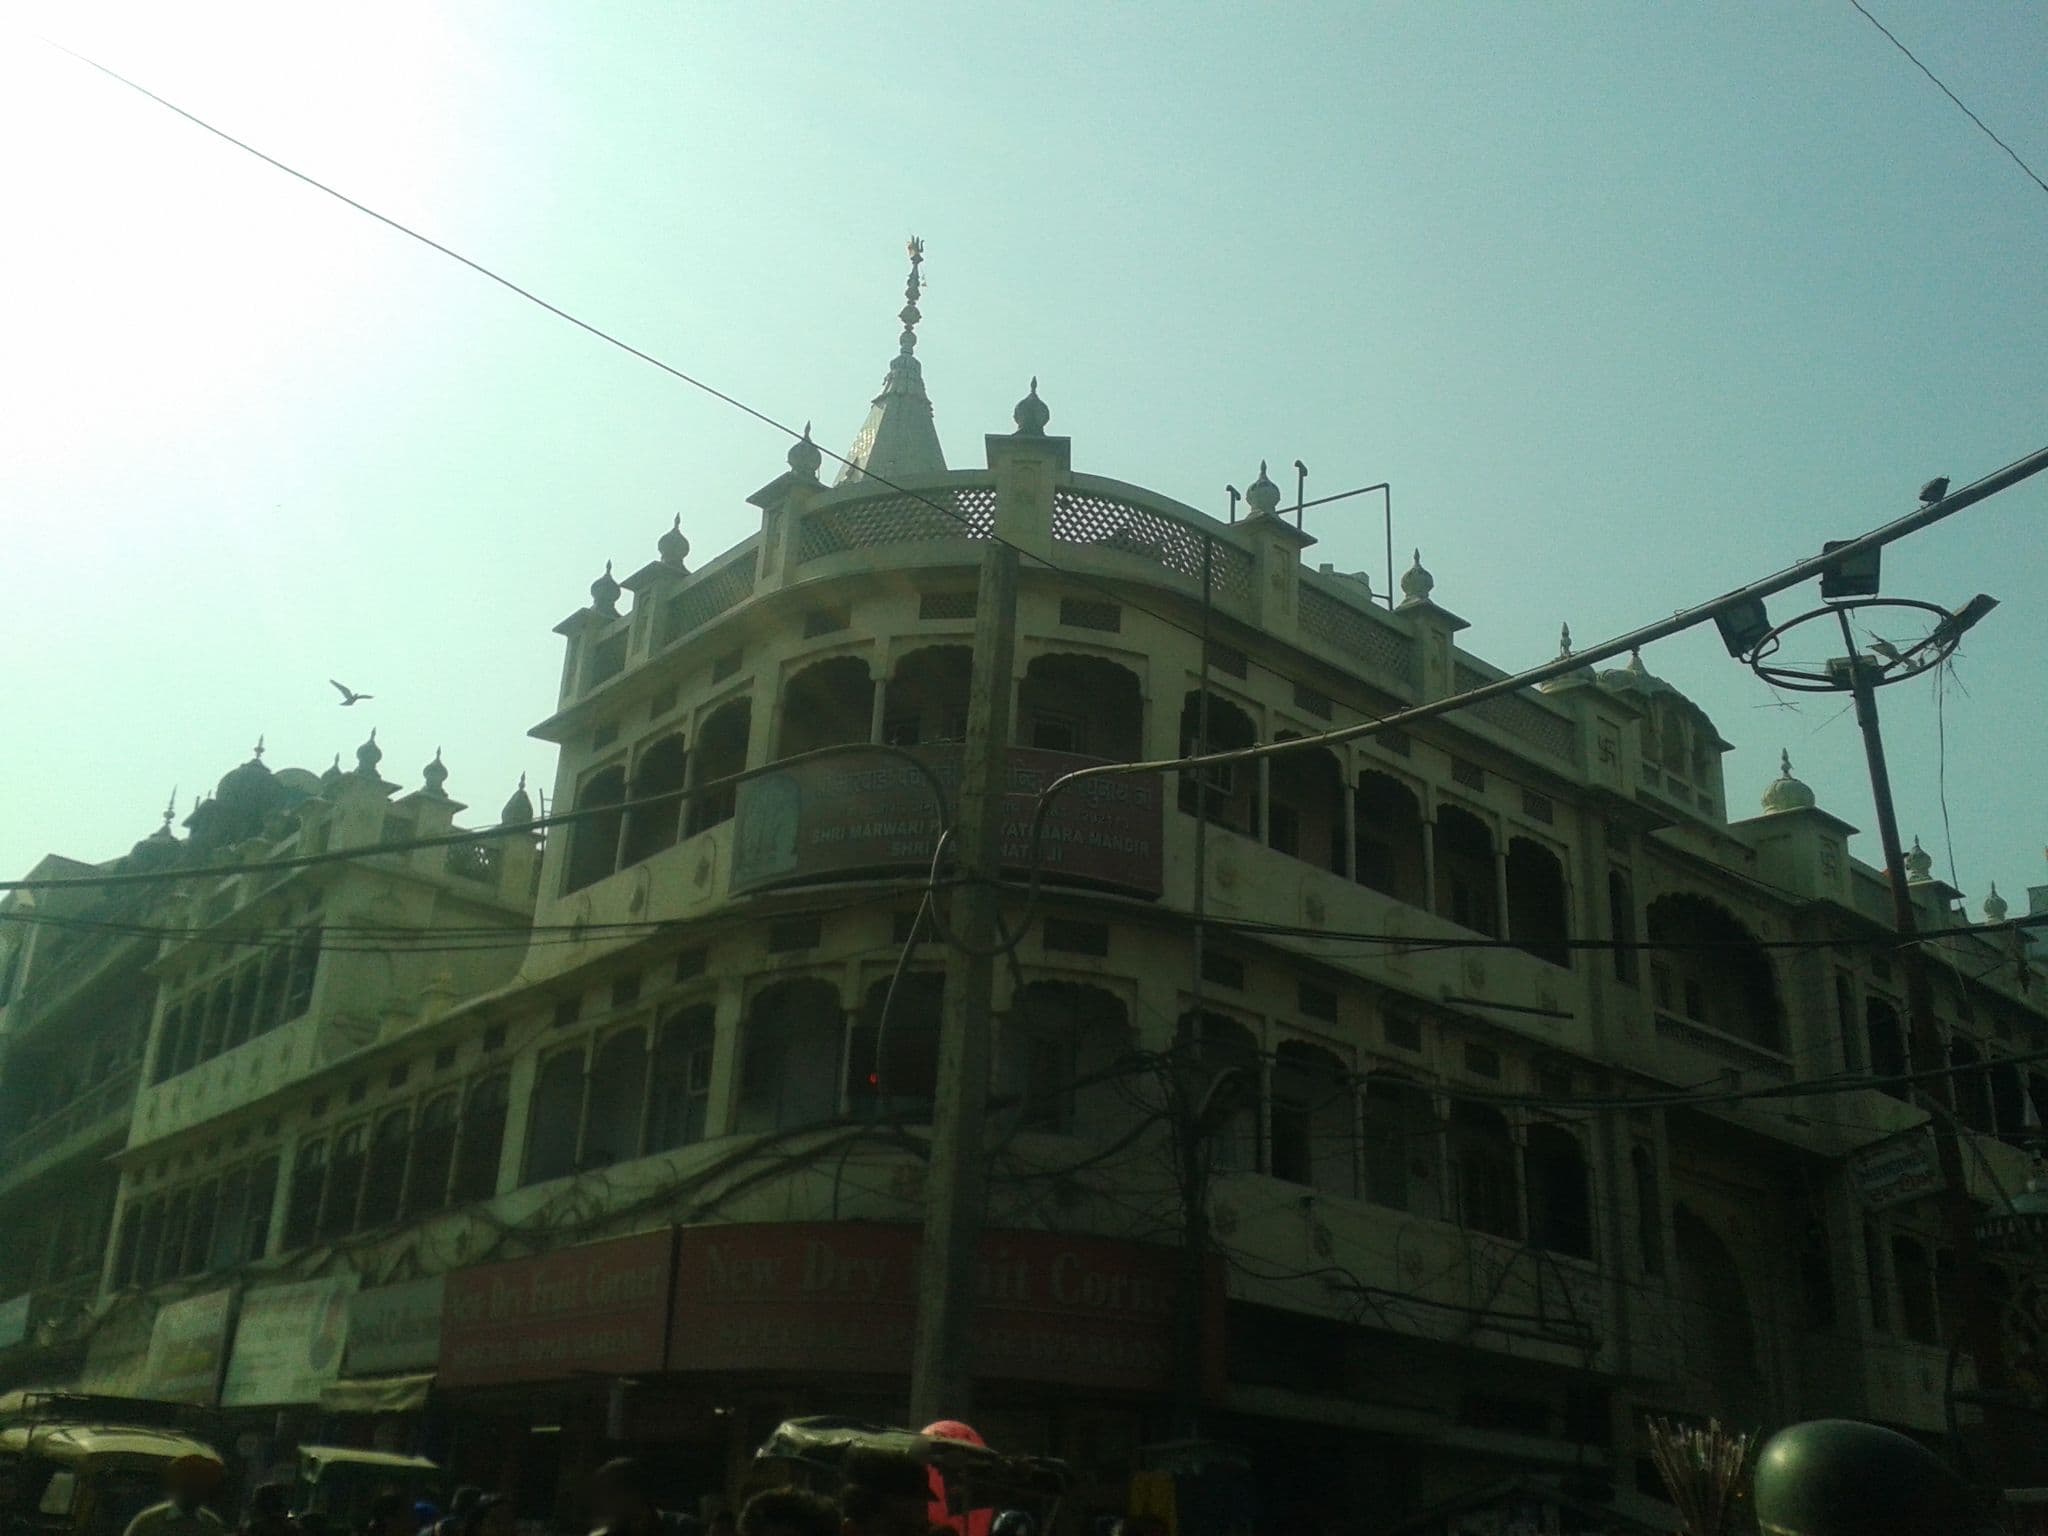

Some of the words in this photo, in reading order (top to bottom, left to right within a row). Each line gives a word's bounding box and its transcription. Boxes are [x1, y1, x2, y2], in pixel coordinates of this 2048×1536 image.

[811, 828, 845, 844] SHRI
[849, 820, 925, 839] MARWARI
[1040, 823, 1084, 844] BARA
[1088, 831, 1150, 857] MANDIR
[890, 841, 930, 857] SHRI
[585, 1262, 661, 1305] Corner
[703, 1243, 784, 1293] New
[801, 1240, 889, 1302] Dry
